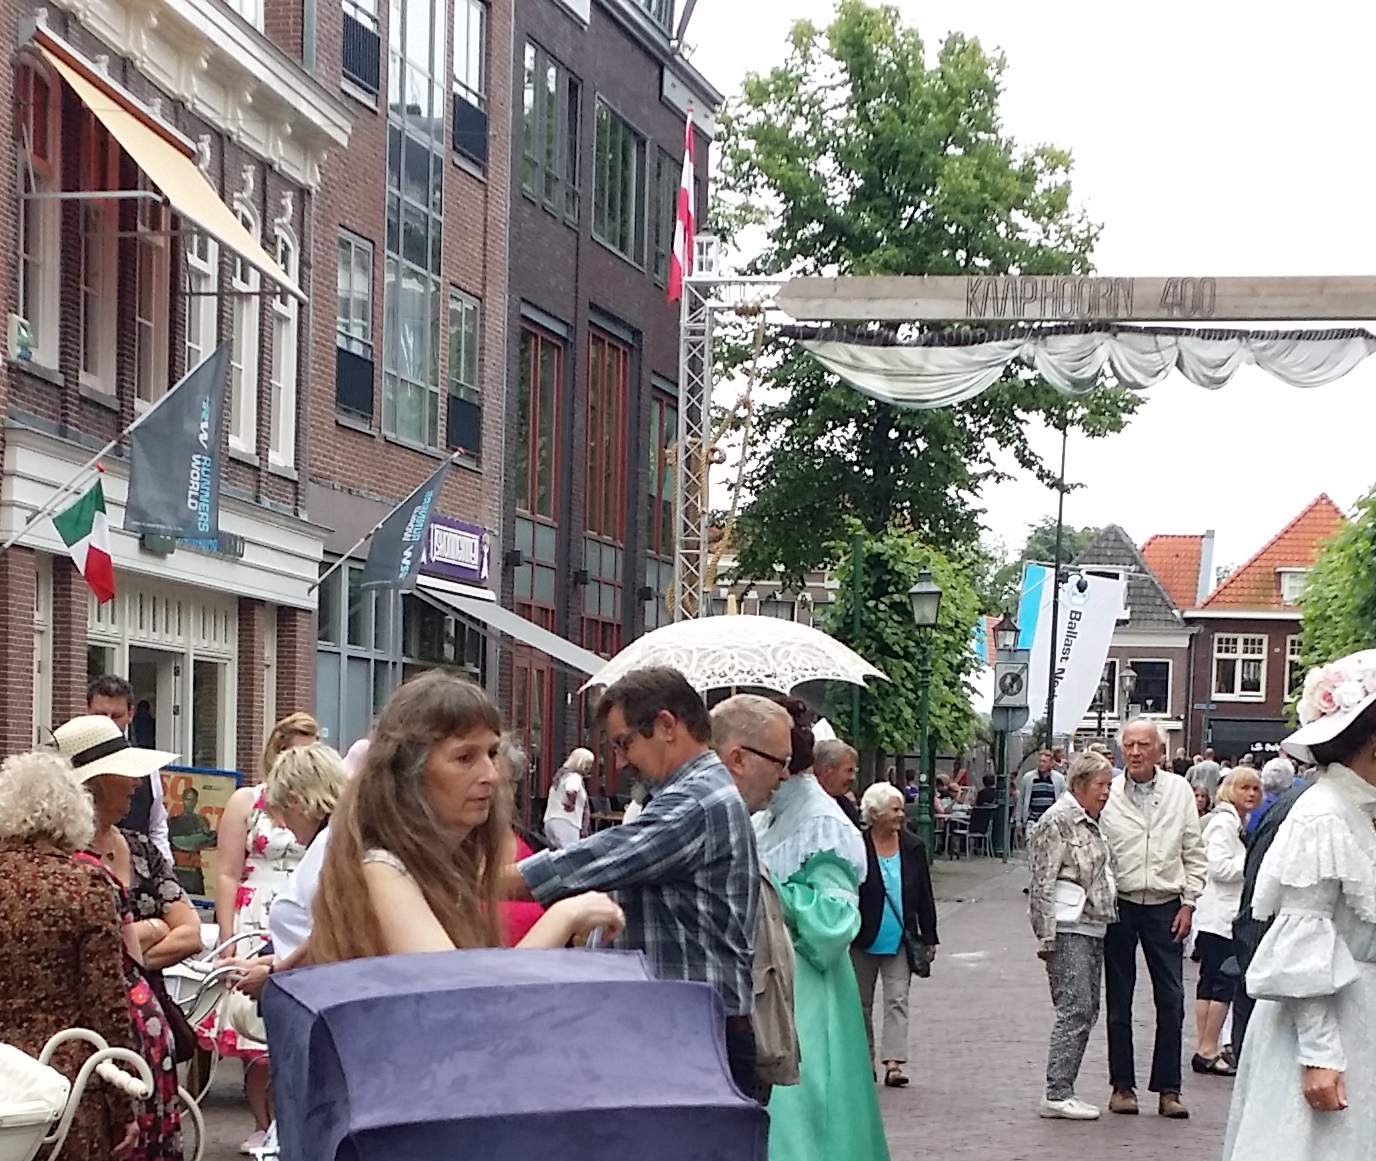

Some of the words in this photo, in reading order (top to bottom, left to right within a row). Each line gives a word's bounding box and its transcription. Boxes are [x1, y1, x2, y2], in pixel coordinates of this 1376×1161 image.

[965, 276, 1134, 318] KAAPHOORN
[1159, 276, 1217, 318] 400
[187, 453, 202, 511] WORLD
[198, 455, 212, 533] RUNNERS
[1059, 609, 1083, 663] Ballast
